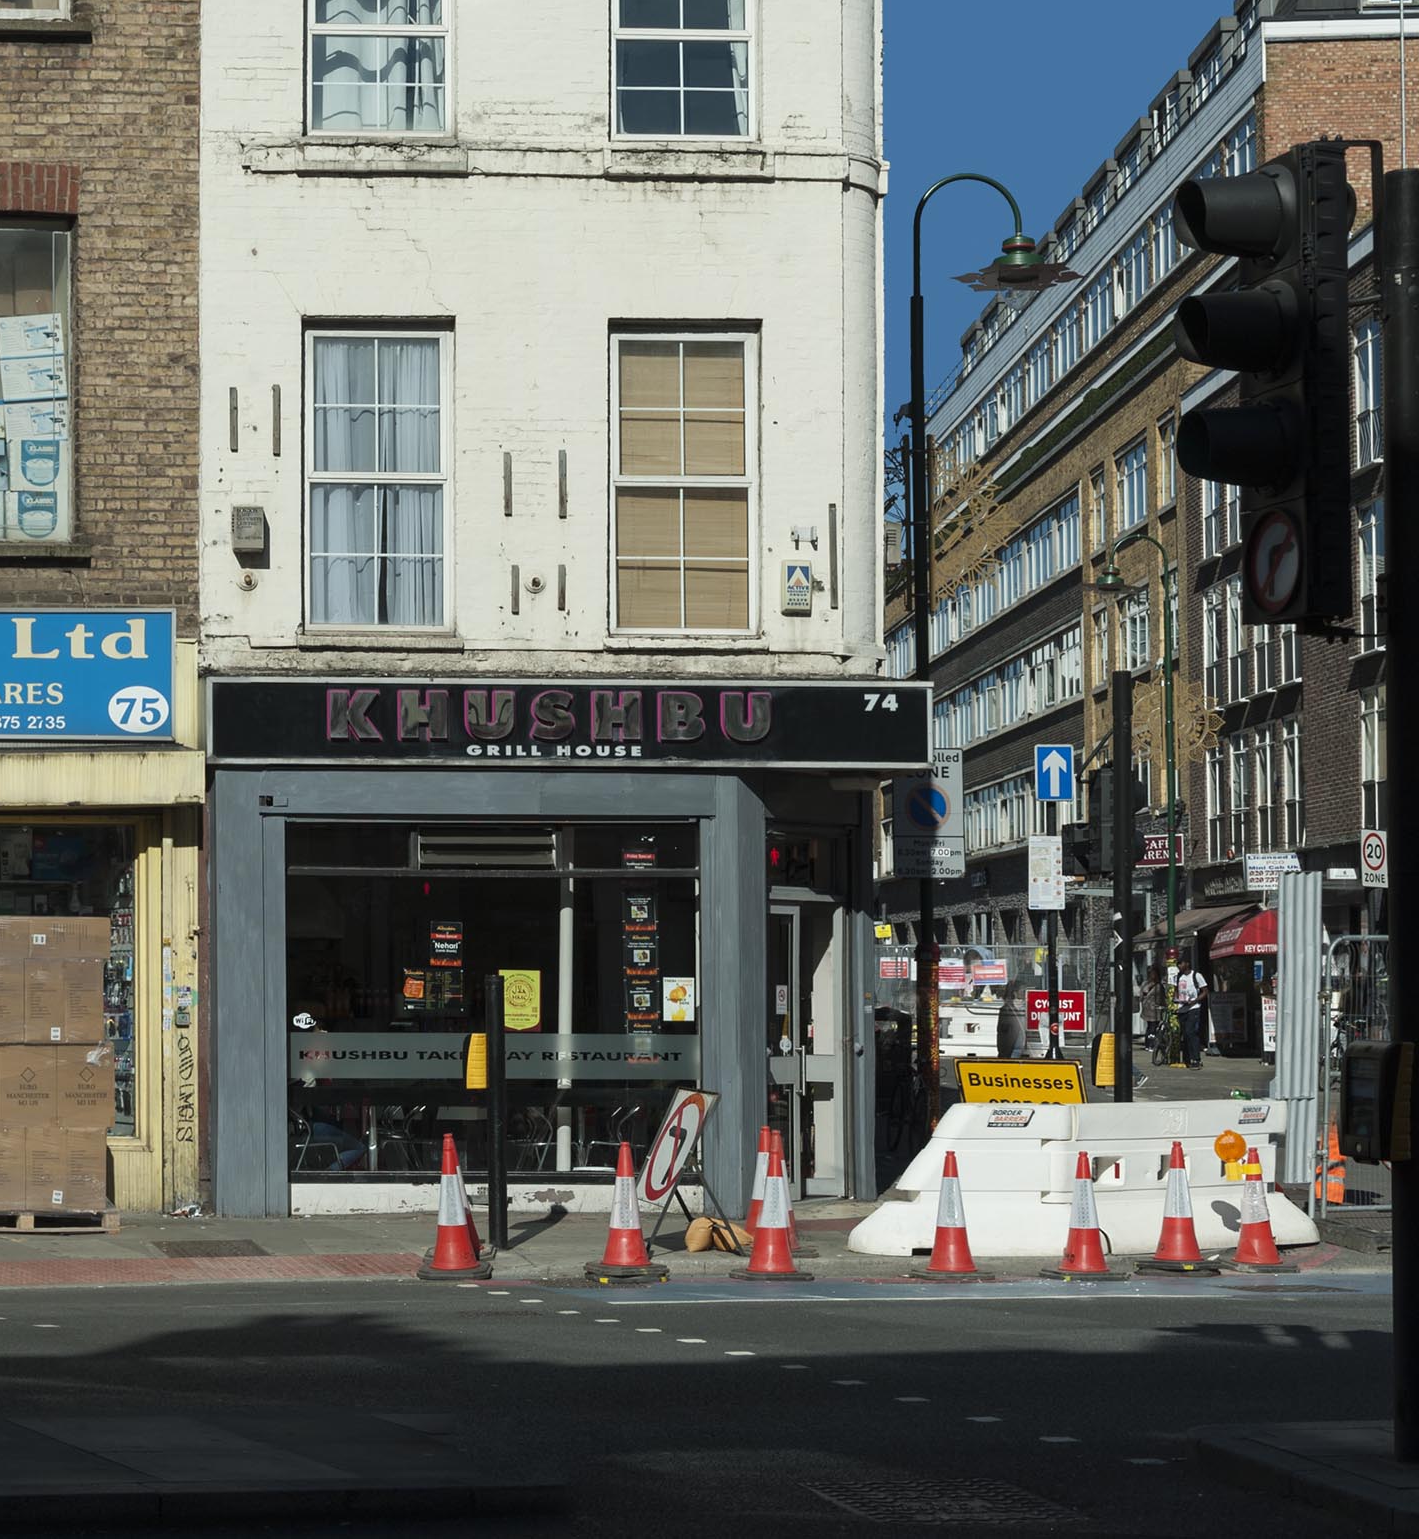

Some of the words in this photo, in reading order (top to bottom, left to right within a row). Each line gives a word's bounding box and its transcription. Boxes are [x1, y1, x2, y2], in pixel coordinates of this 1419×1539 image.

[11, 618, 149, 660] Ltd
[863, 693, 898, 712] 74
[115, 697, 162, 726] 75
[327, 689, 773, 743] KHUSHBU
[466, 744, 542, 757] GRILL
[556, 744, 643, 757] HOUSE
[1366, 843, 1382, 859] 20
[1364, 872, 1385, 883] ZONE
[1244, 944, 1256, 952] KEY
[1035, 999, 1074, 1009] CYIST
[1031, 1012, 1081, 1021] DIUNT
[298, 1050, 408, 1061] KHUSHBU
[968, 1073, 1074, 1090] Businesses
